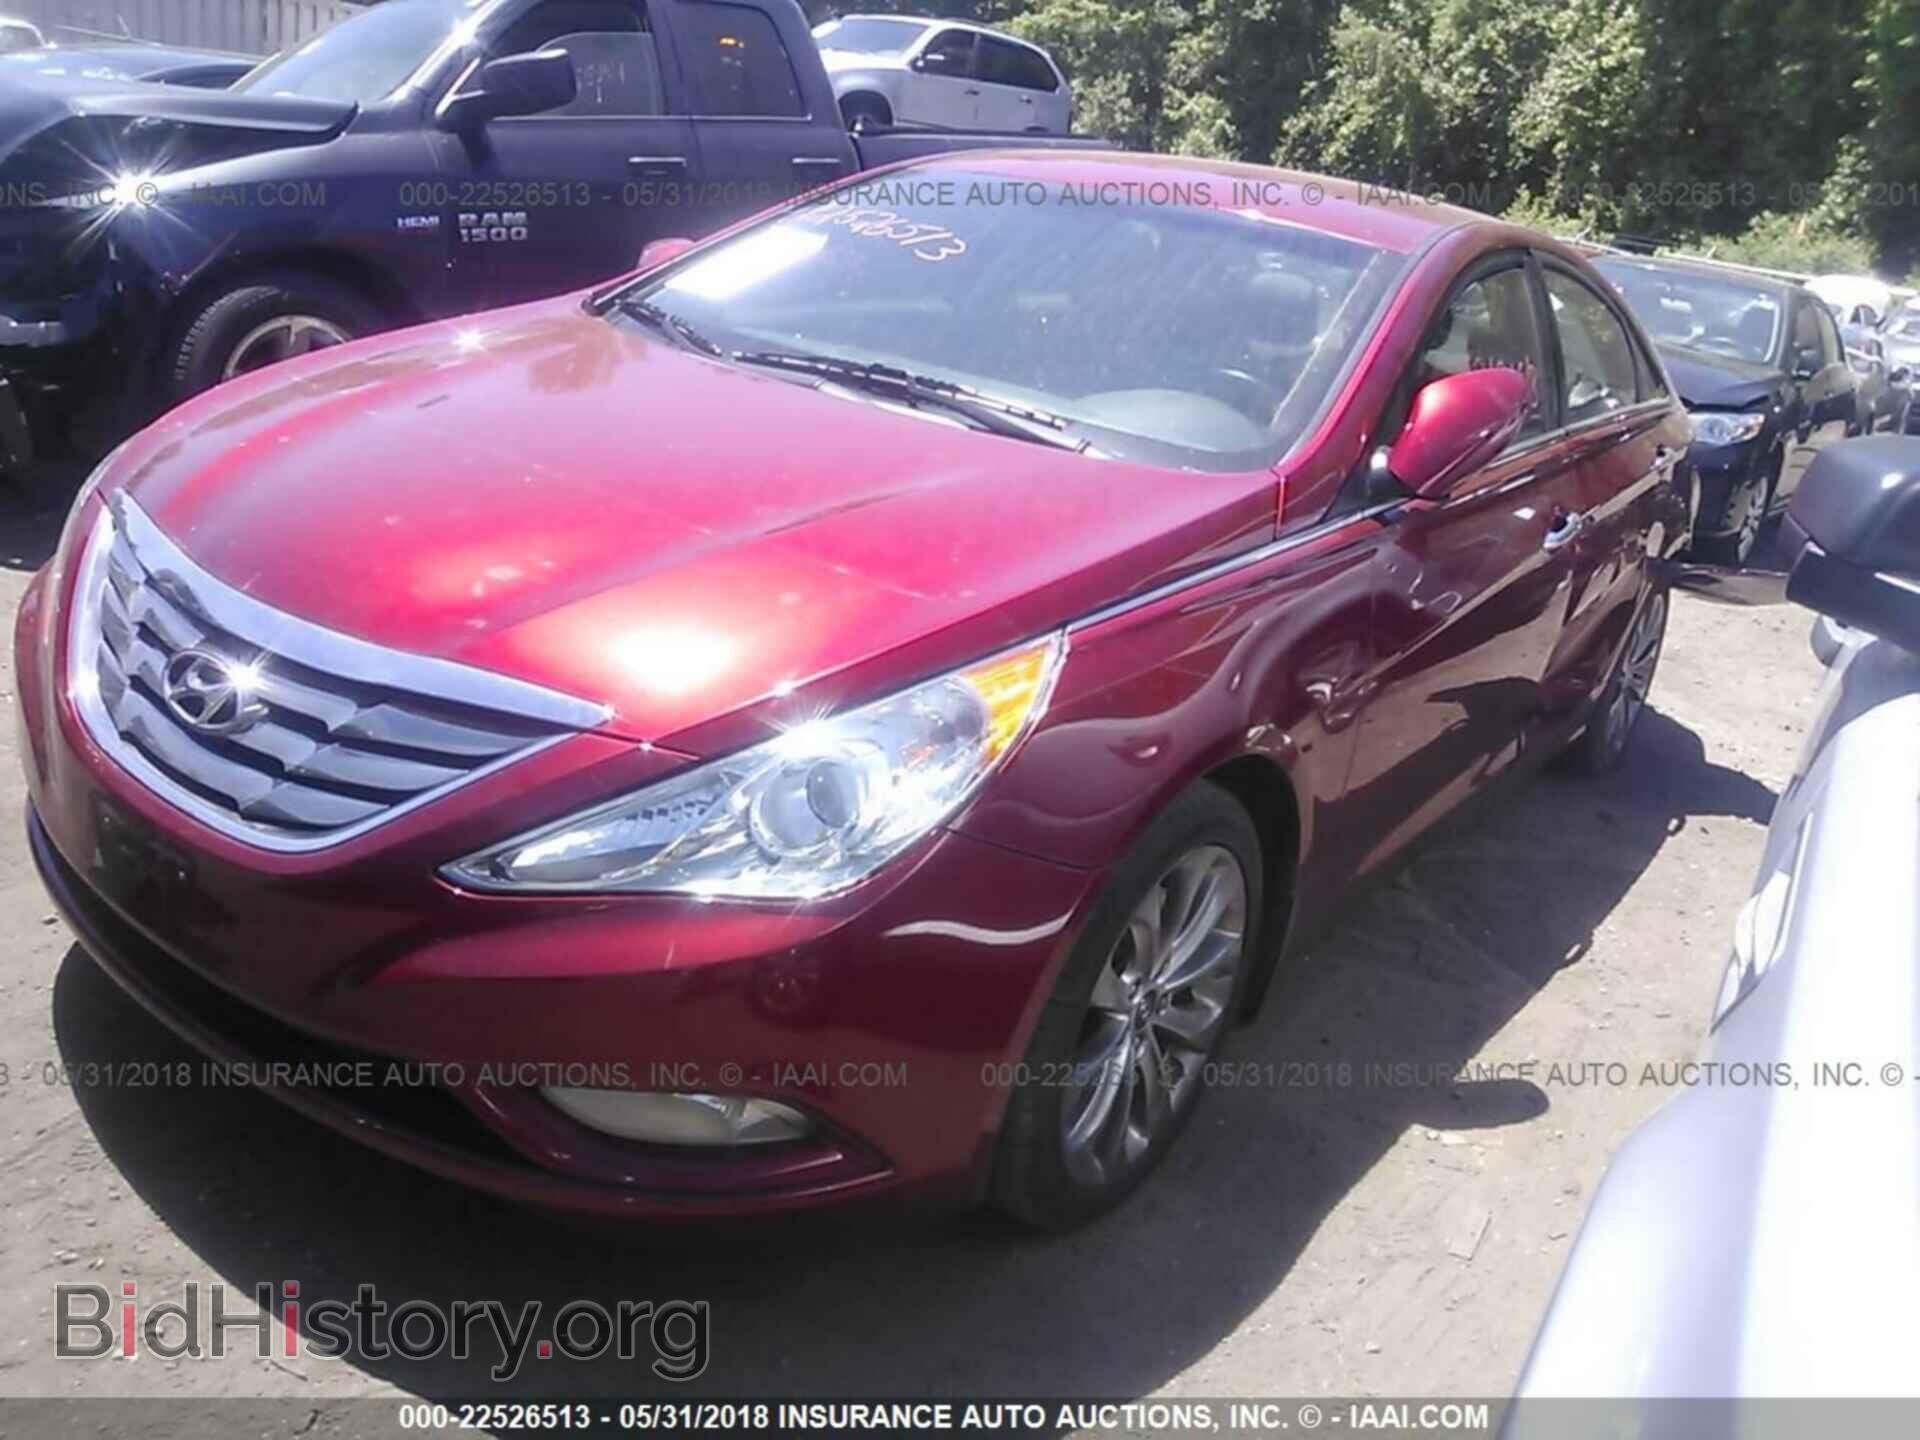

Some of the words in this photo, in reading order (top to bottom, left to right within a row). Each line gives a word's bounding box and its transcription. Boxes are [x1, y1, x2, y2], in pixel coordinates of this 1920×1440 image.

[397, 215, 440, 228] HEMI
[458, 211, 528, 227] RAM
[460, 226, 528, 242] 1500
